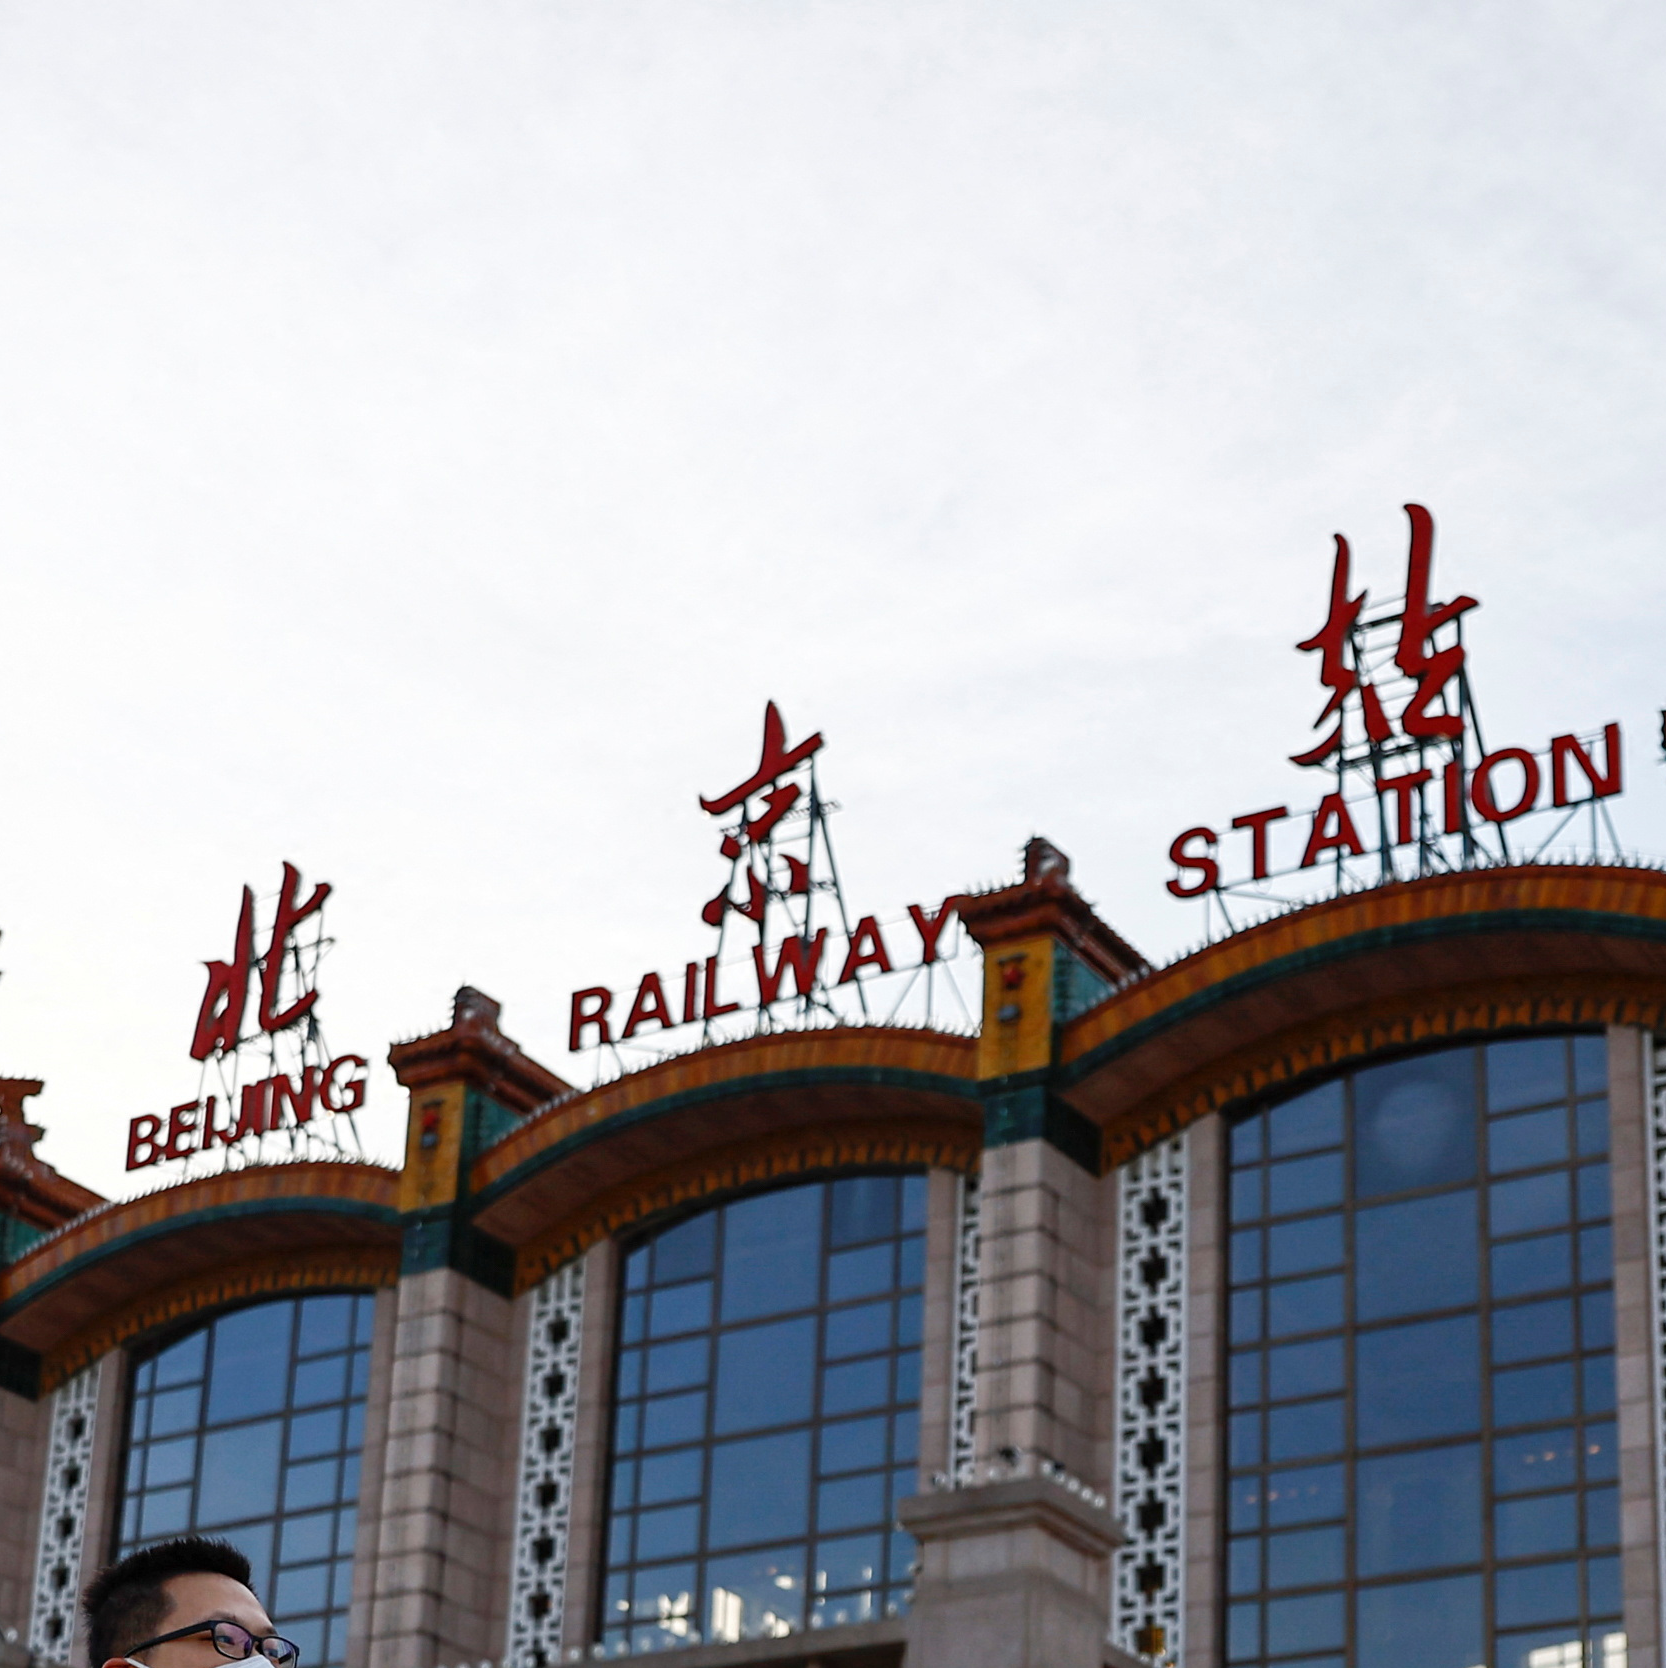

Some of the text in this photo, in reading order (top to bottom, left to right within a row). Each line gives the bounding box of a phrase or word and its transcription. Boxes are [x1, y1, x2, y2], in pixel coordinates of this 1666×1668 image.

[126, 722, 1622, 1171] BEIJING RAILWAY STATION
